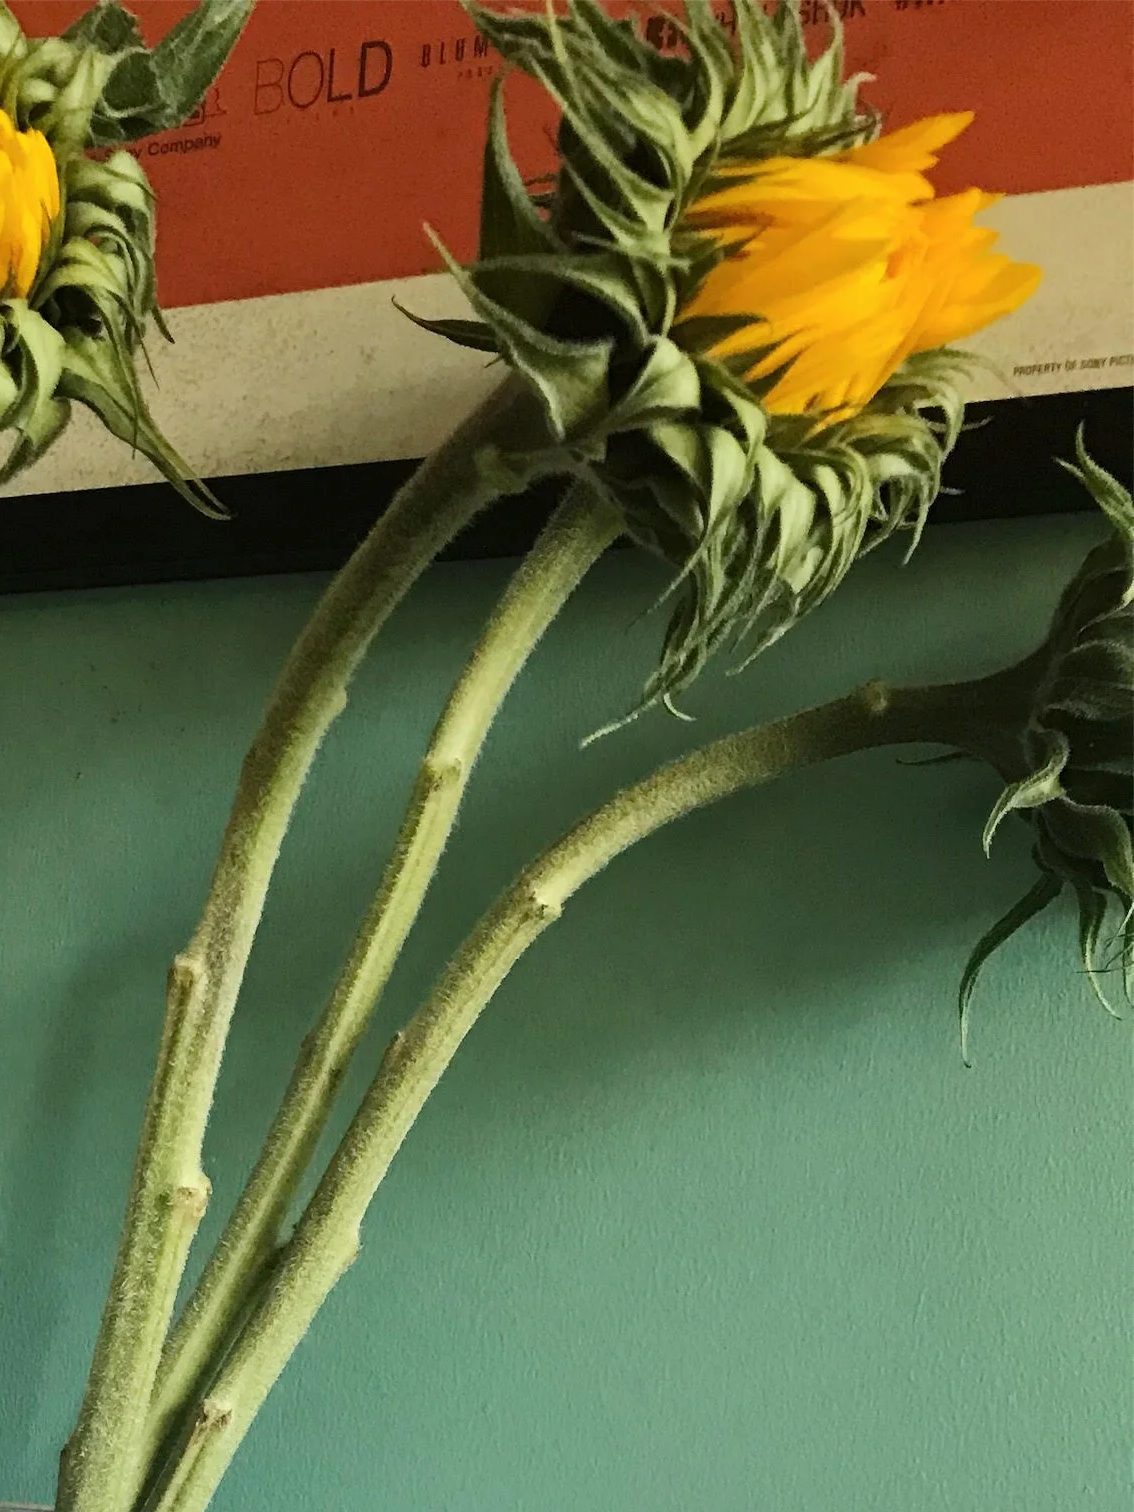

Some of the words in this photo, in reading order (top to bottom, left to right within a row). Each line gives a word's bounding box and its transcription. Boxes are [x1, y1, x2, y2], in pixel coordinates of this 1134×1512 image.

[254, 41, 392, 115] BOLD
[147, 133, 222, 157] Company
[1013, 363, 1061, 376] PROPERTY
[1080, 358, 1106, 369] SONY
